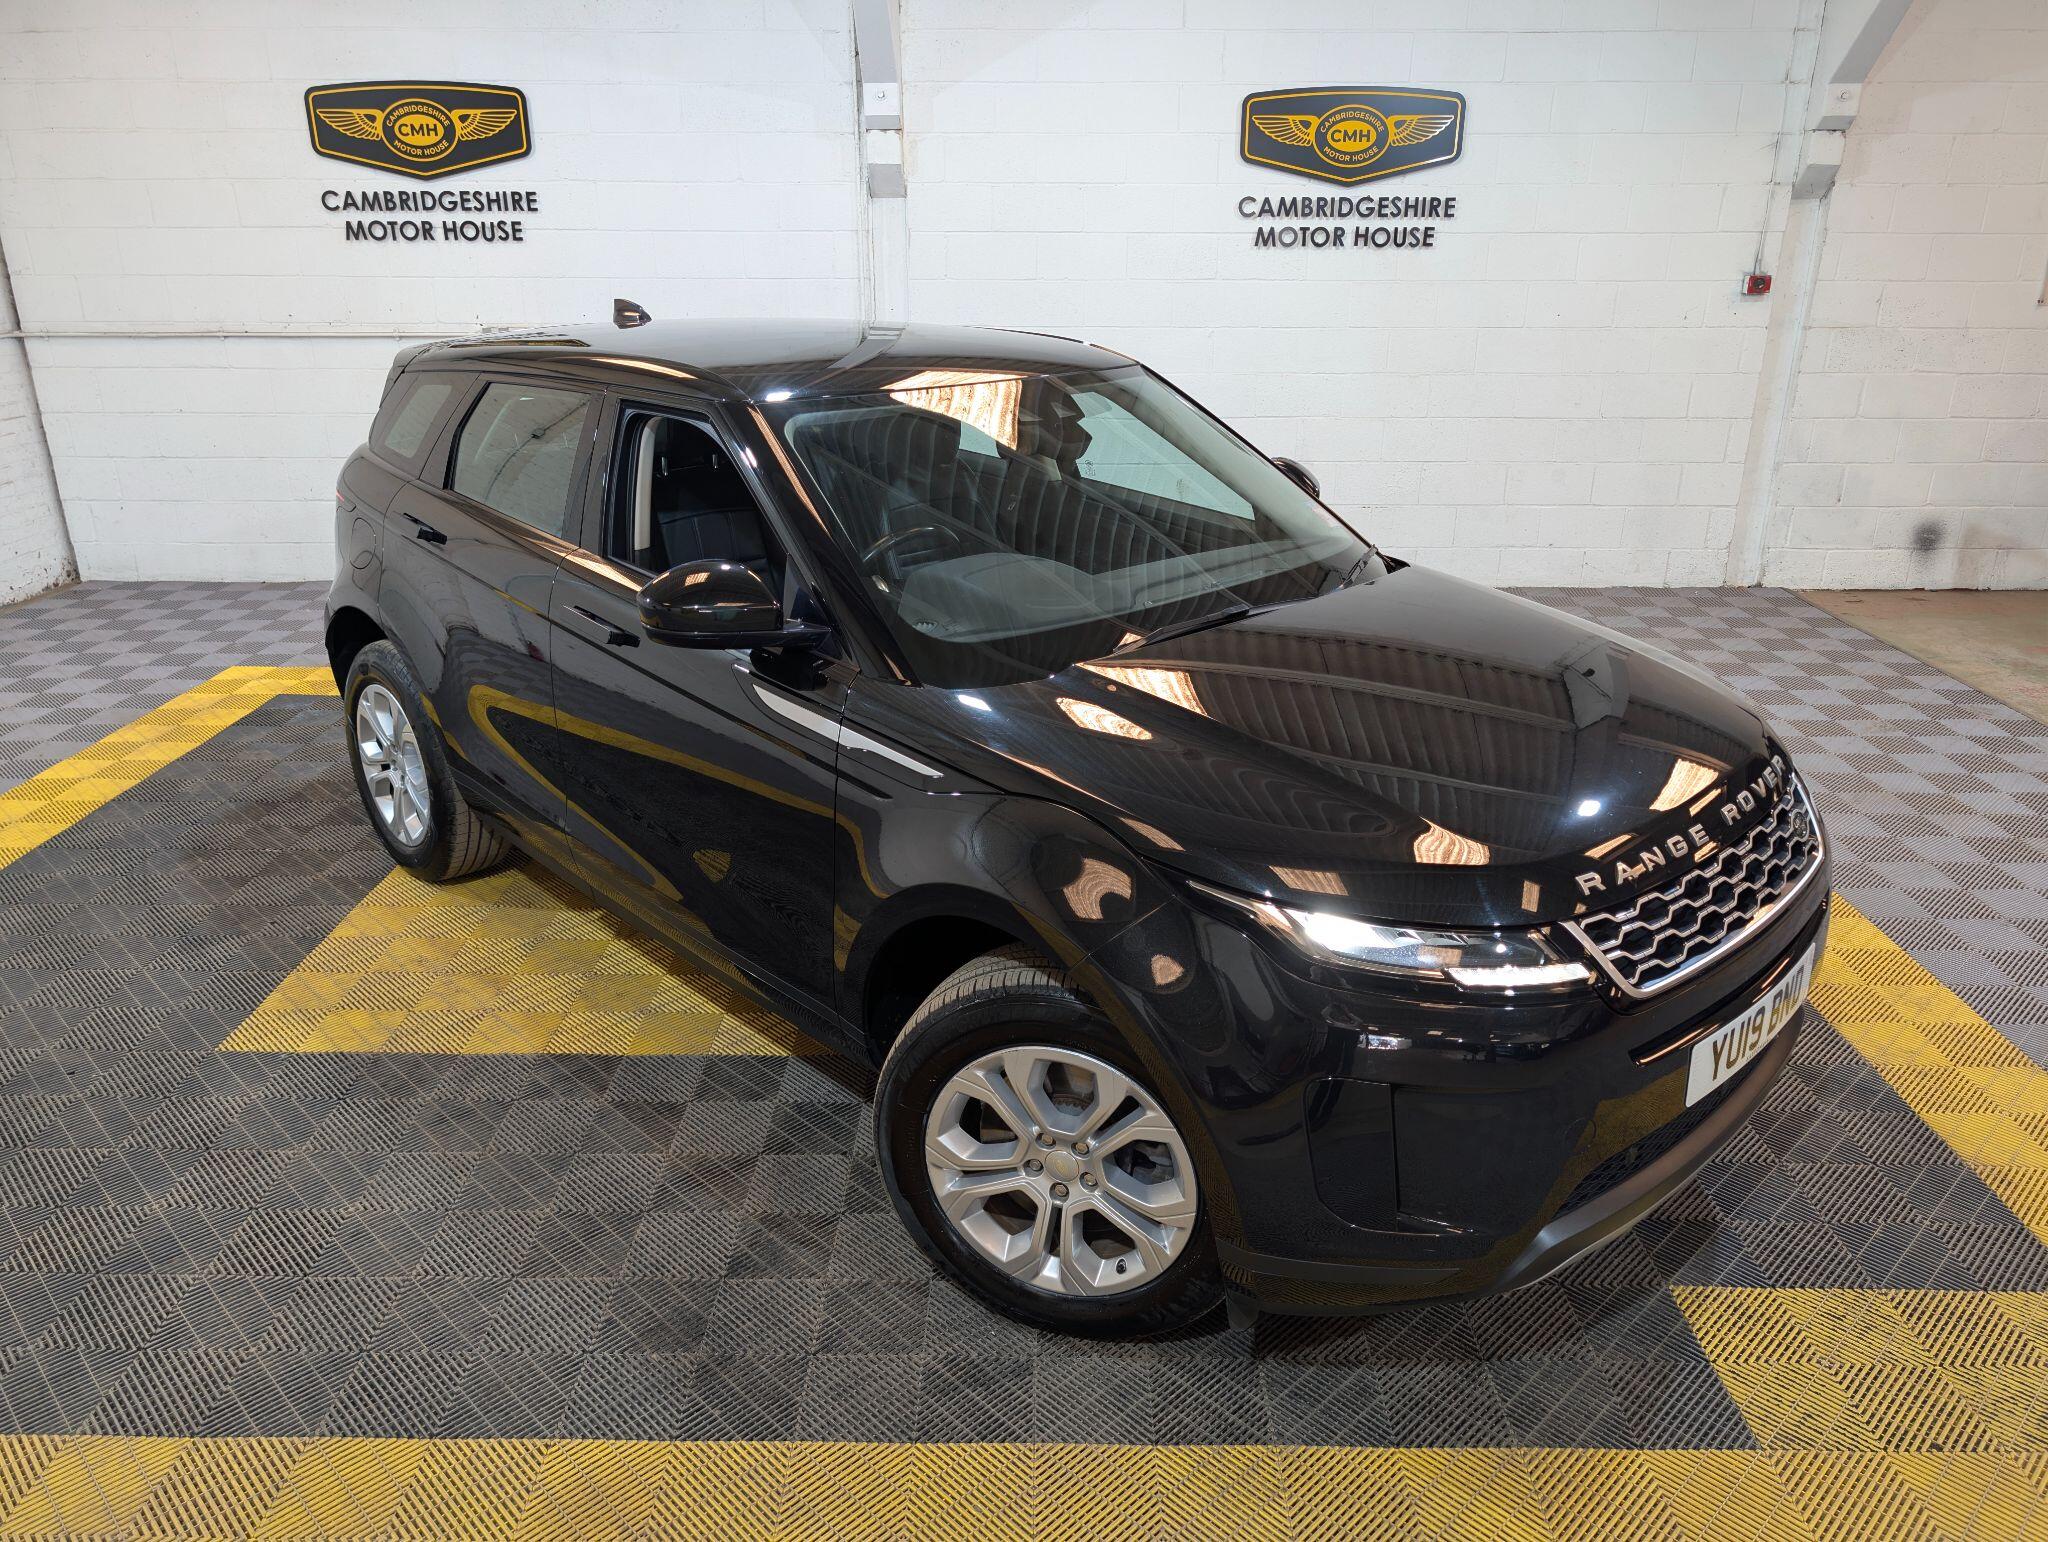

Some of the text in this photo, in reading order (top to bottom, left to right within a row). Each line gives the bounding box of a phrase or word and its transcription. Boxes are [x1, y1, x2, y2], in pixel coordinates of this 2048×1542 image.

[386, 105, 451, 127] CAMBRIDGESHIRE
[1320, 111, 1385, 133] CAMBRIDGESHIRE
[398, 123, 439, 137] CMH
[1331, 129, 1371, 143] CMH
[393, 139, 450, 156] MOTOR HOUSE
[1323, 145, 1379, 162] MOTOR HOUSE
[321, 189, 539, 212] CAMBRIDGESHIRE
[1238, 195, 1457, 218] CAMBRIDGESHIRE
[345, 220, 524, 242] MOTOR HOUSE
[1254, 226, 1436, 248] MOTOR HOUSE
[1575, 754, 1787, 896] RANGE ROVER
[1712, 1005, 1766, 1082] YU19
